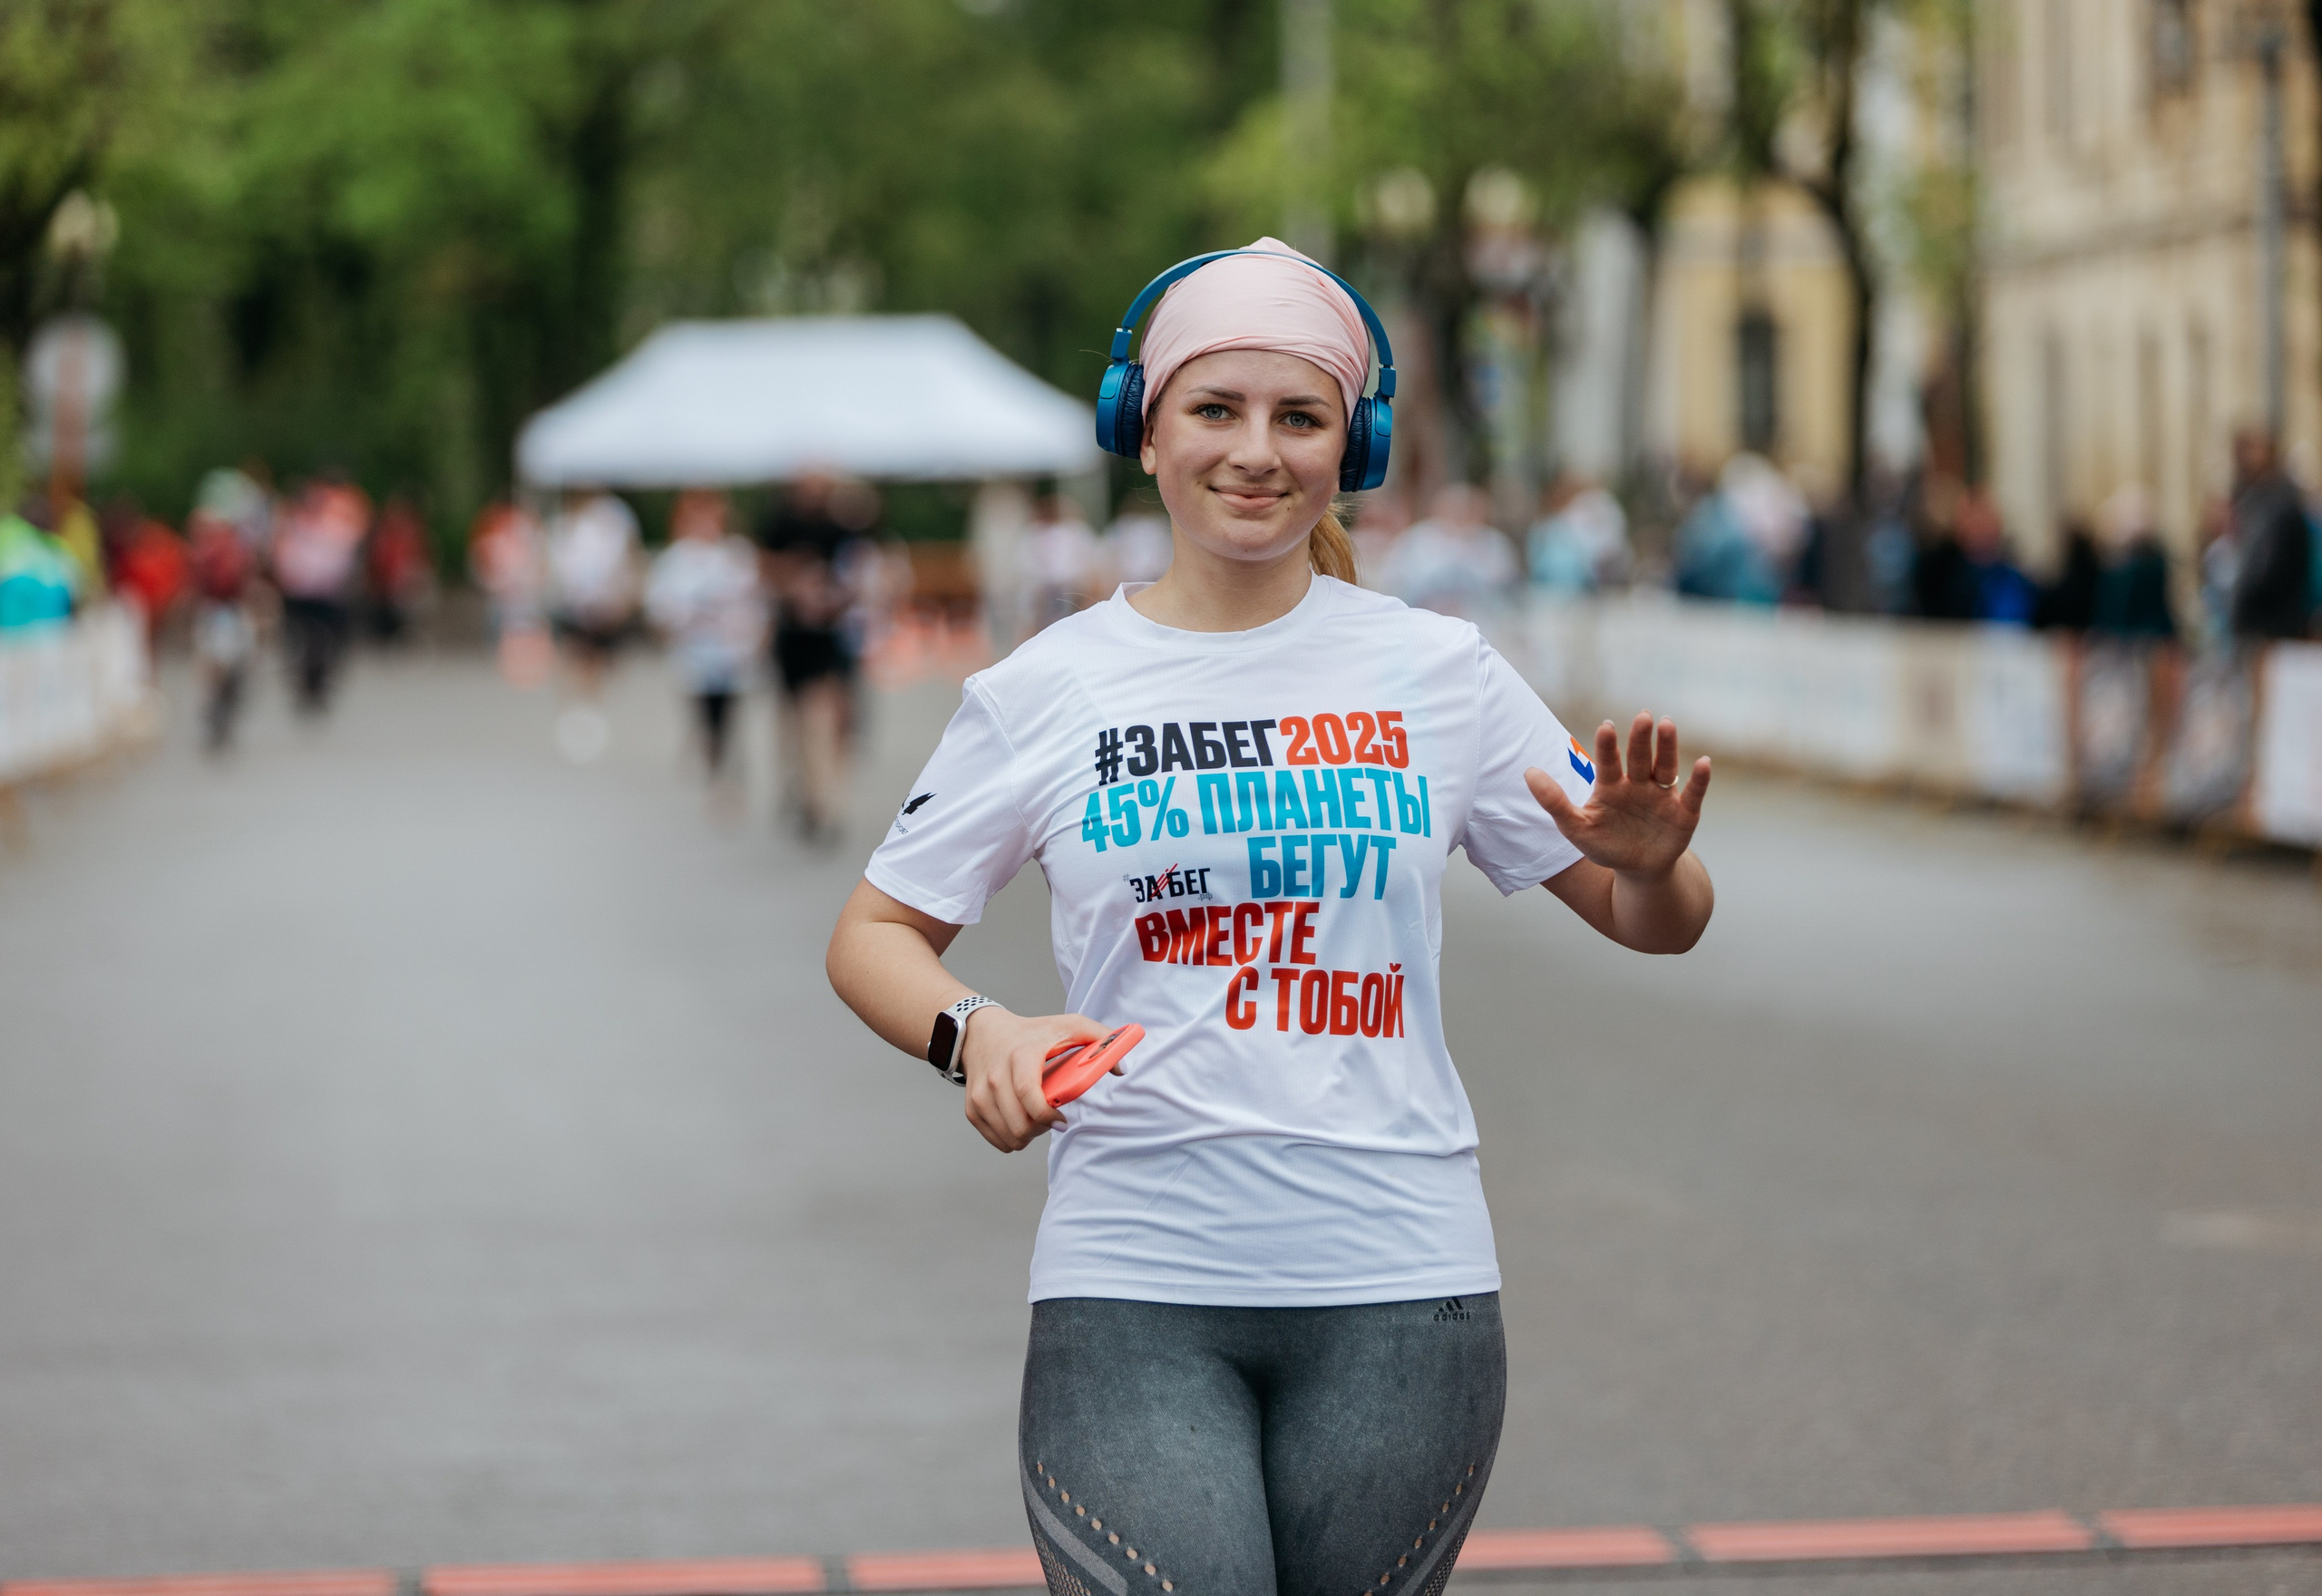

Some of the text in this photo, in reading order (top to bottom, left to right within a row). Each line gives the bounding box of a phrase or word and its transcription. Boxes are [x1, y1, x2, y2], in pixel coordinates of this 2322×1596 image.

[1081, 767, 1431, 852] 45% ПЛАНЕТЫ
[1246, 834, 1397, 900] БЕГУТ
[1135, 901, 1321, 966] ВМЕСТЕ
[1225, 963, 1405, 1038] С ТОБОЙ
[1433, 1310, 1470, 1322] adidas
